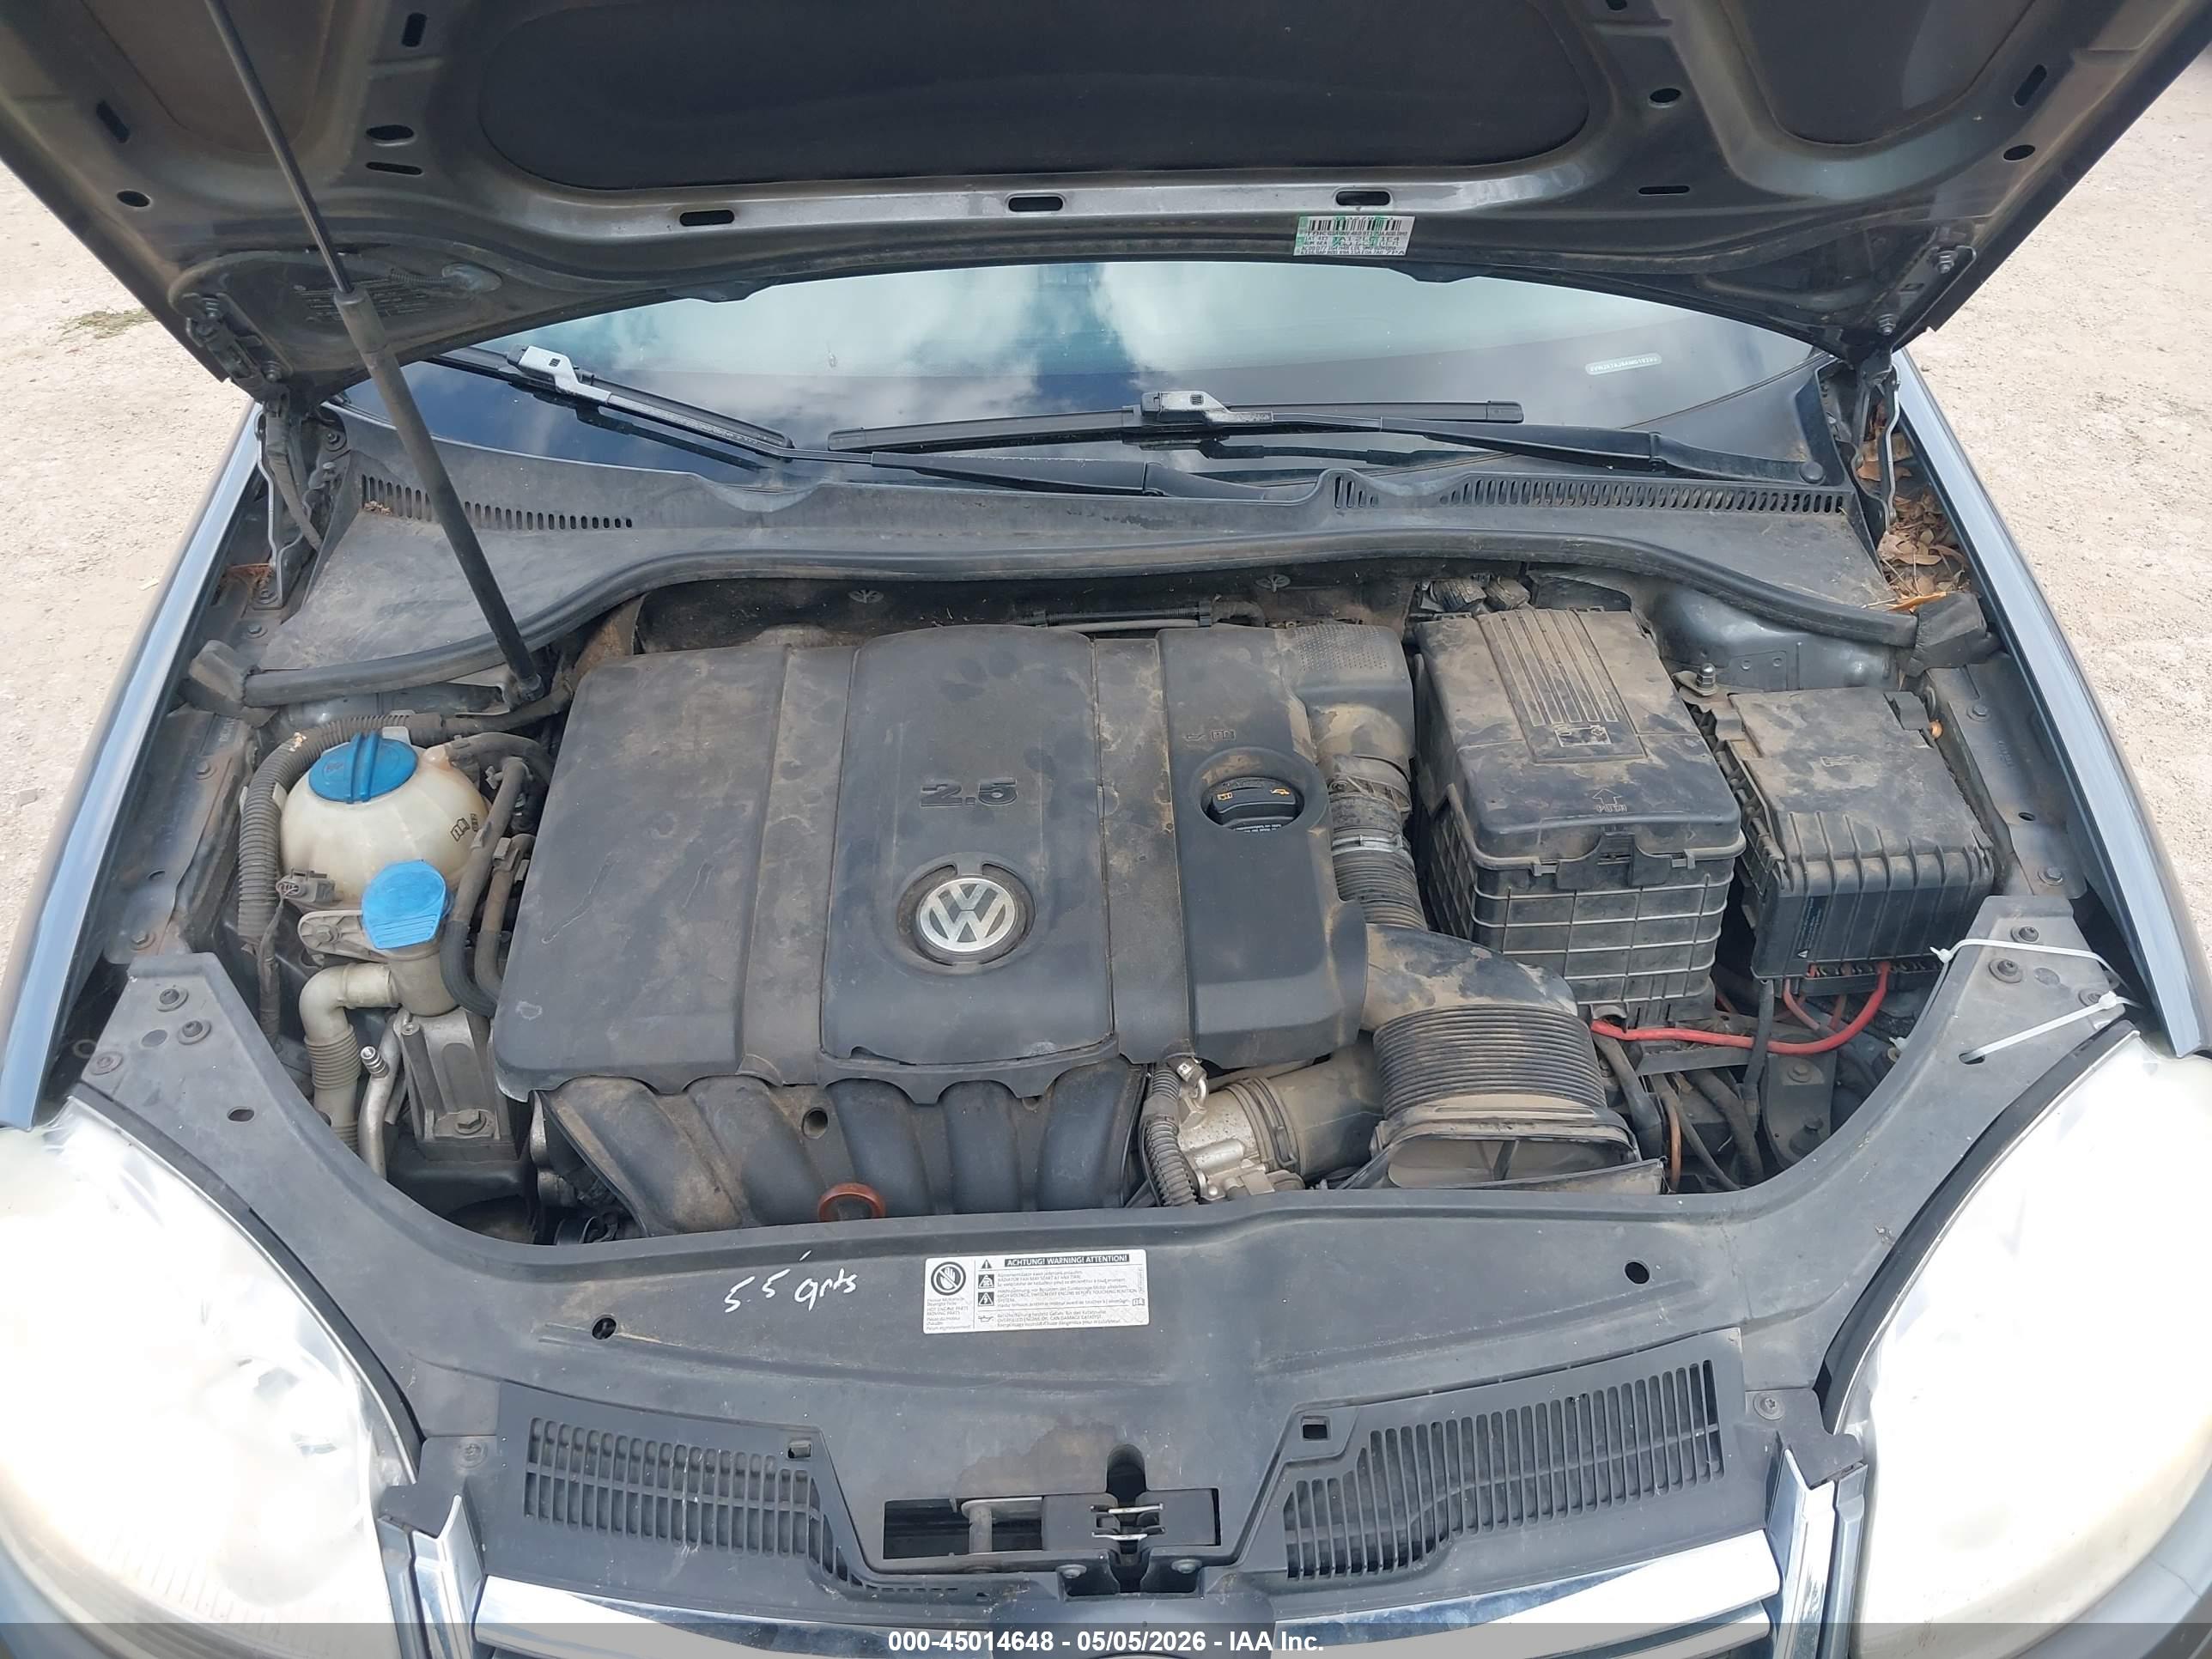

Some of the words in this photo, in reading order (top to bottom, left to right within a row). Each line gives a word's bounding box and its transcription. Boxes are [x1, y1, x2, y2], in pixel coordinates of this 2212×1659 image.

[919, 777, 1018, 808] 2.5
[918, 877, 1018, 953] VW
[1006, 1256, 1045, 1267] ACHTUNG!
[1047, 1255, 1085, 1265] WARNING!
[1085, 1254, 1127, 1264] ATTENTION!
